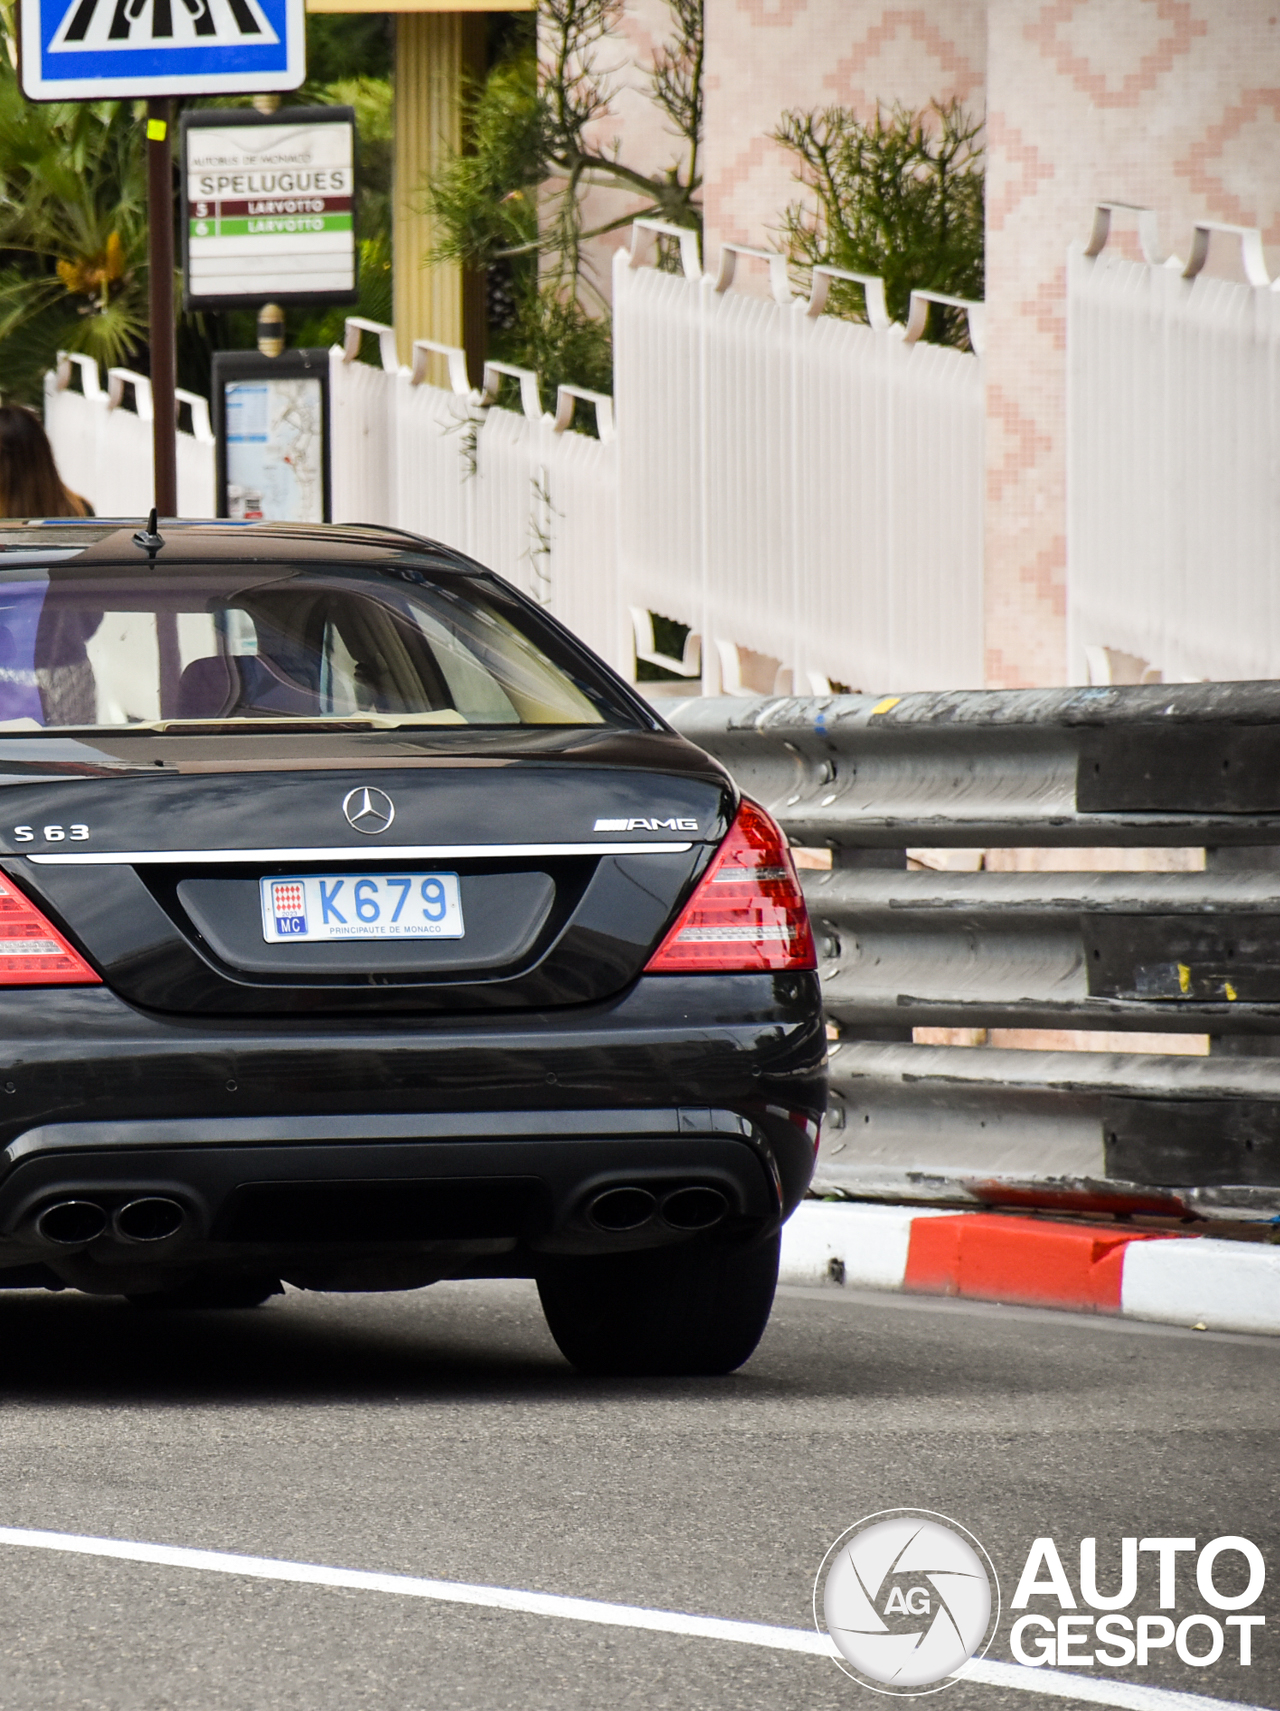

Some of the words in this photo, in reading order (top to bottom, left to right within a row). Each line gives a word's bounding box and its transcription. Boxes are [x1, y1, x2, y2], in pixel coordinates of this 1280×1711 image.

[242, 154, 256, 165] DE
[200, 171, 346, 195] SPELUGUES
[195, 202, 209, 218] 5
[247, 198, 326, 215] LARVOTTO
[195, 221, 209, 237] 6
[247, 217, 326, 233] LARVOTTO
[14, 825, 34, 842] S
[43, 824, 90, 842] 63
[626, 818, 699, 832] AMG
[318, 877, 447, 925] K679
[280, 918, 300, 933] MC
[329, 926, 386, 935] PRINCIPAUTE
[389, 926, 400, 934] DE
[404, 925, 442, 933] MONACO
